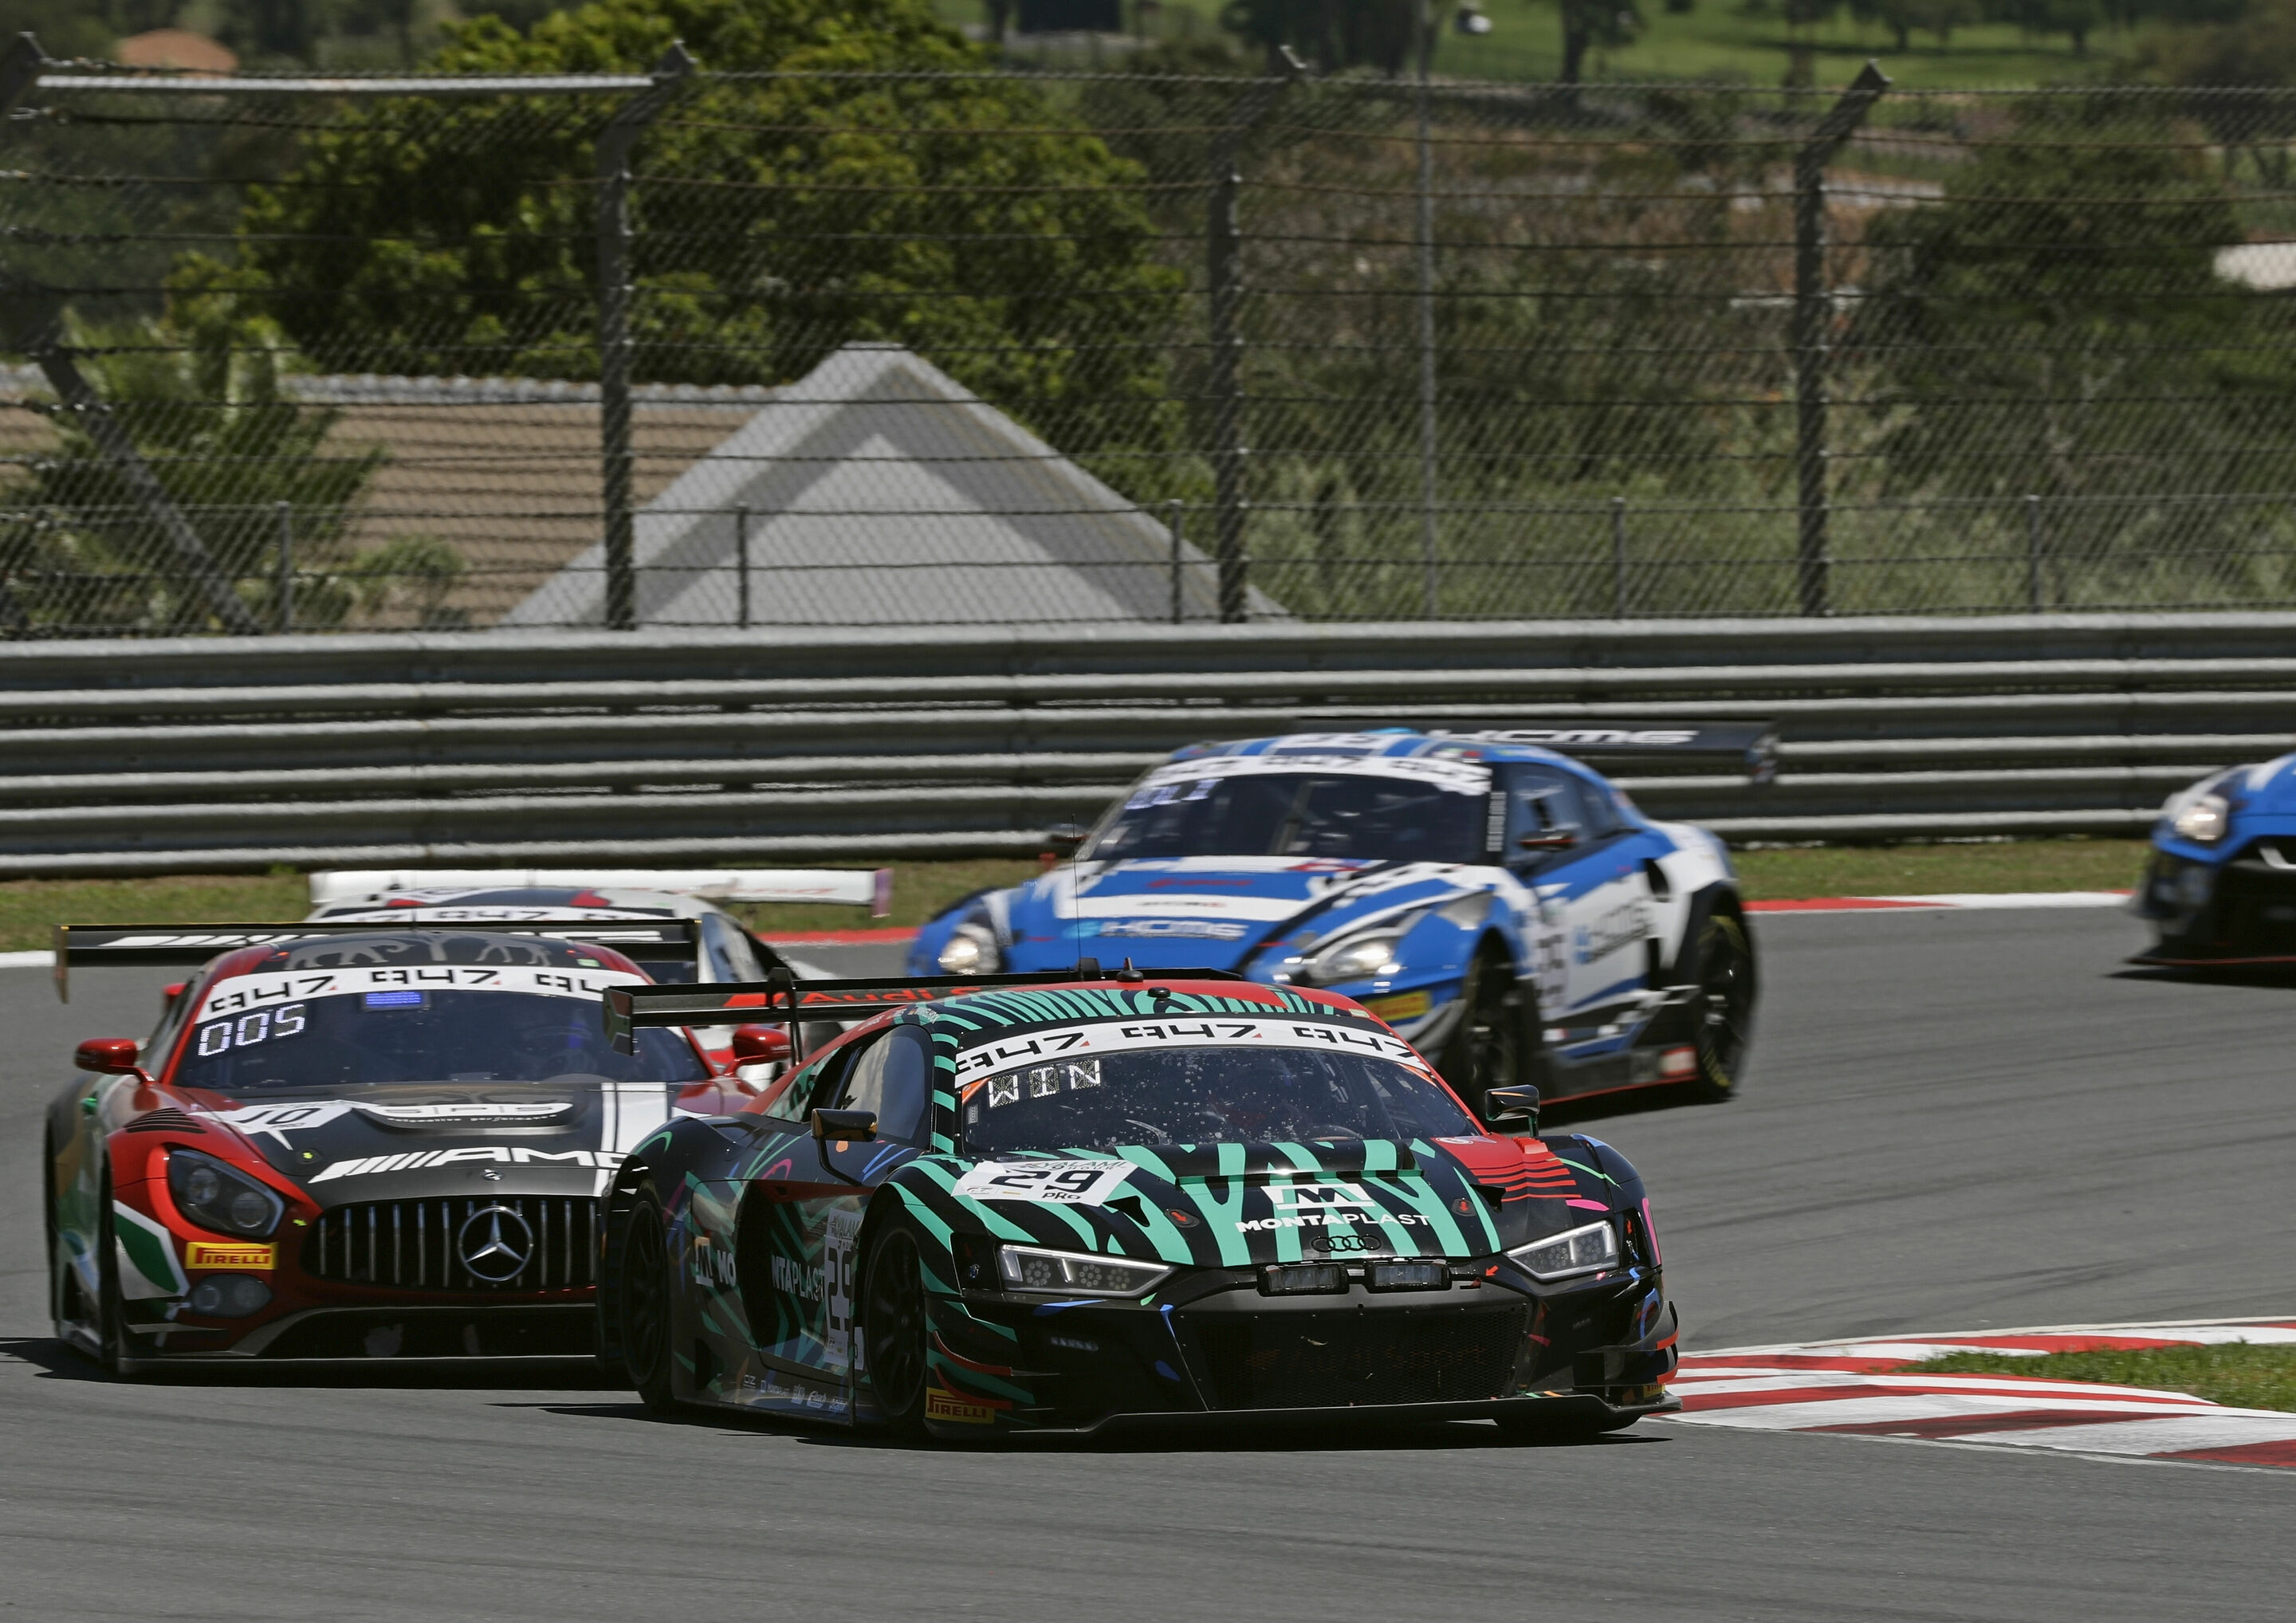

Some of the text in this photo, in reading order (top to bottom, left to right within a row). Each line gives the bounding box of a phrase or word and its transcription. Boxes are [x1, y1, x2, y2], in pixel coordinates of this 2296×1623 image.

[371, 969, 501, 985] 947
[535, 973, 604, 993] 94
[210, 975, 336, 1013] 947
[800, 988, 935, 1004] Audi
[198, 1004, 305, 1056] 005
[1120, 1024, 1258, 1040] 947
[956, 1032, 1085, 1075] 947
[988, 1059, 1102, 1108] WIN
[989, 1169, 1105, 1193] 29
[1235, 1213, 1431, 1233] MONTAPLAST
[195, 1247, 273, 1264] PIRELLI
[927, 1393, 987, 1419] PIRELLI
